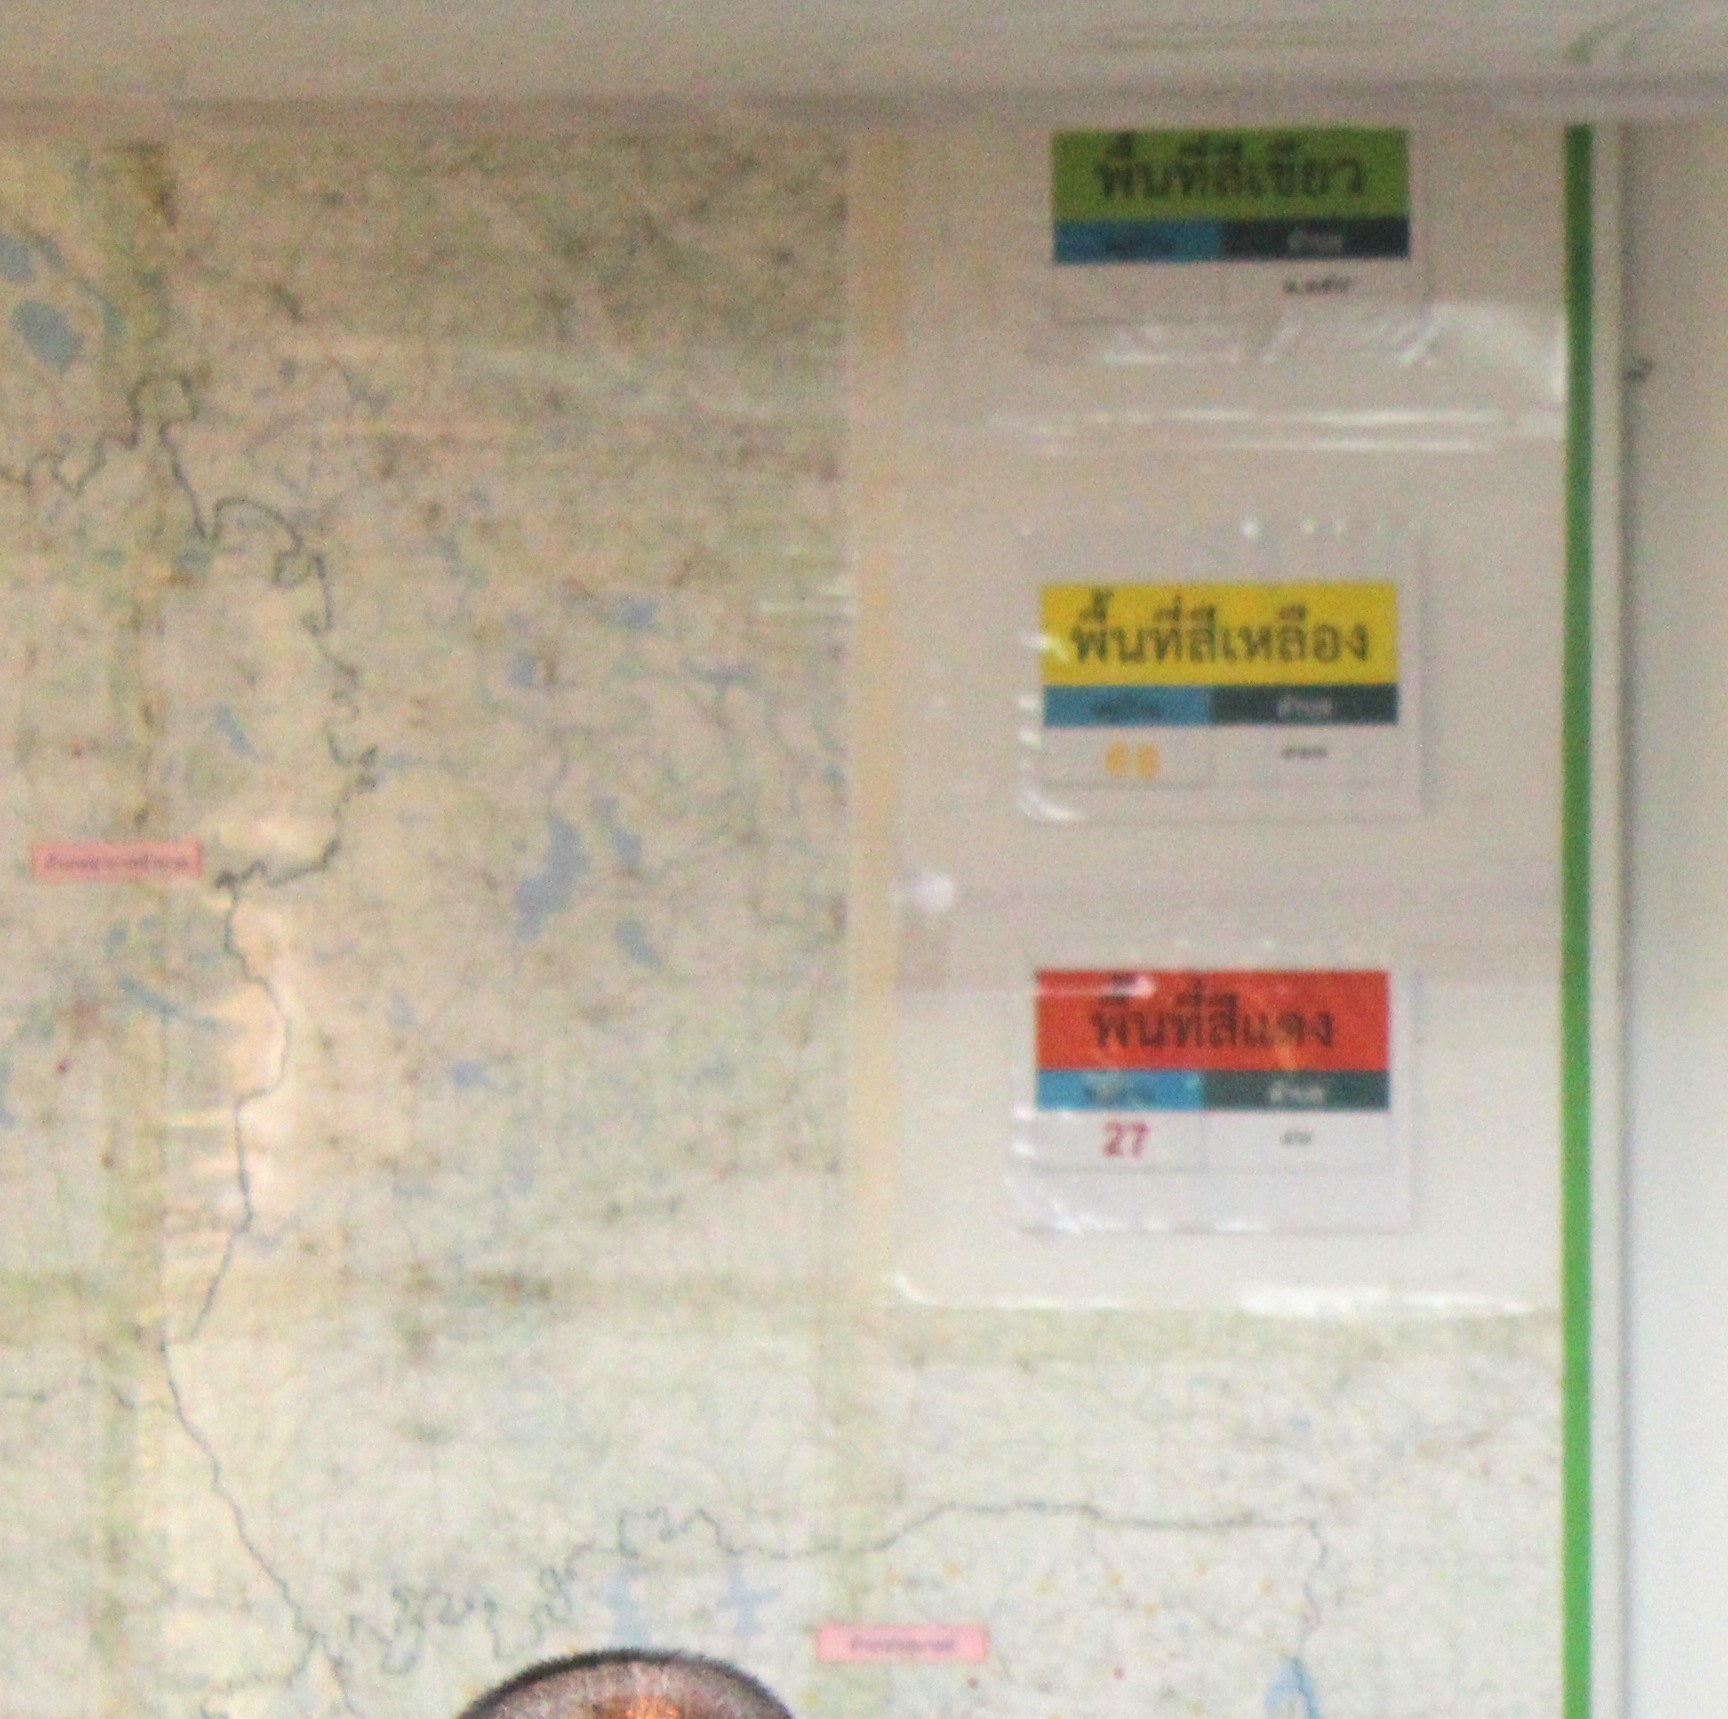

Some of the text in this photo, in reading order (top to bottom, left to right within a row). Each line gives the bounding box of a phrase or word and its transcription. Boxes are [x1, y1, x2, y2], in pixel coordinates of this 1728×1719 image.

[1070, 588, 1370, 664] พื้นที่สีเหลือง
[1103, 1120, 1149, 1158] 27
